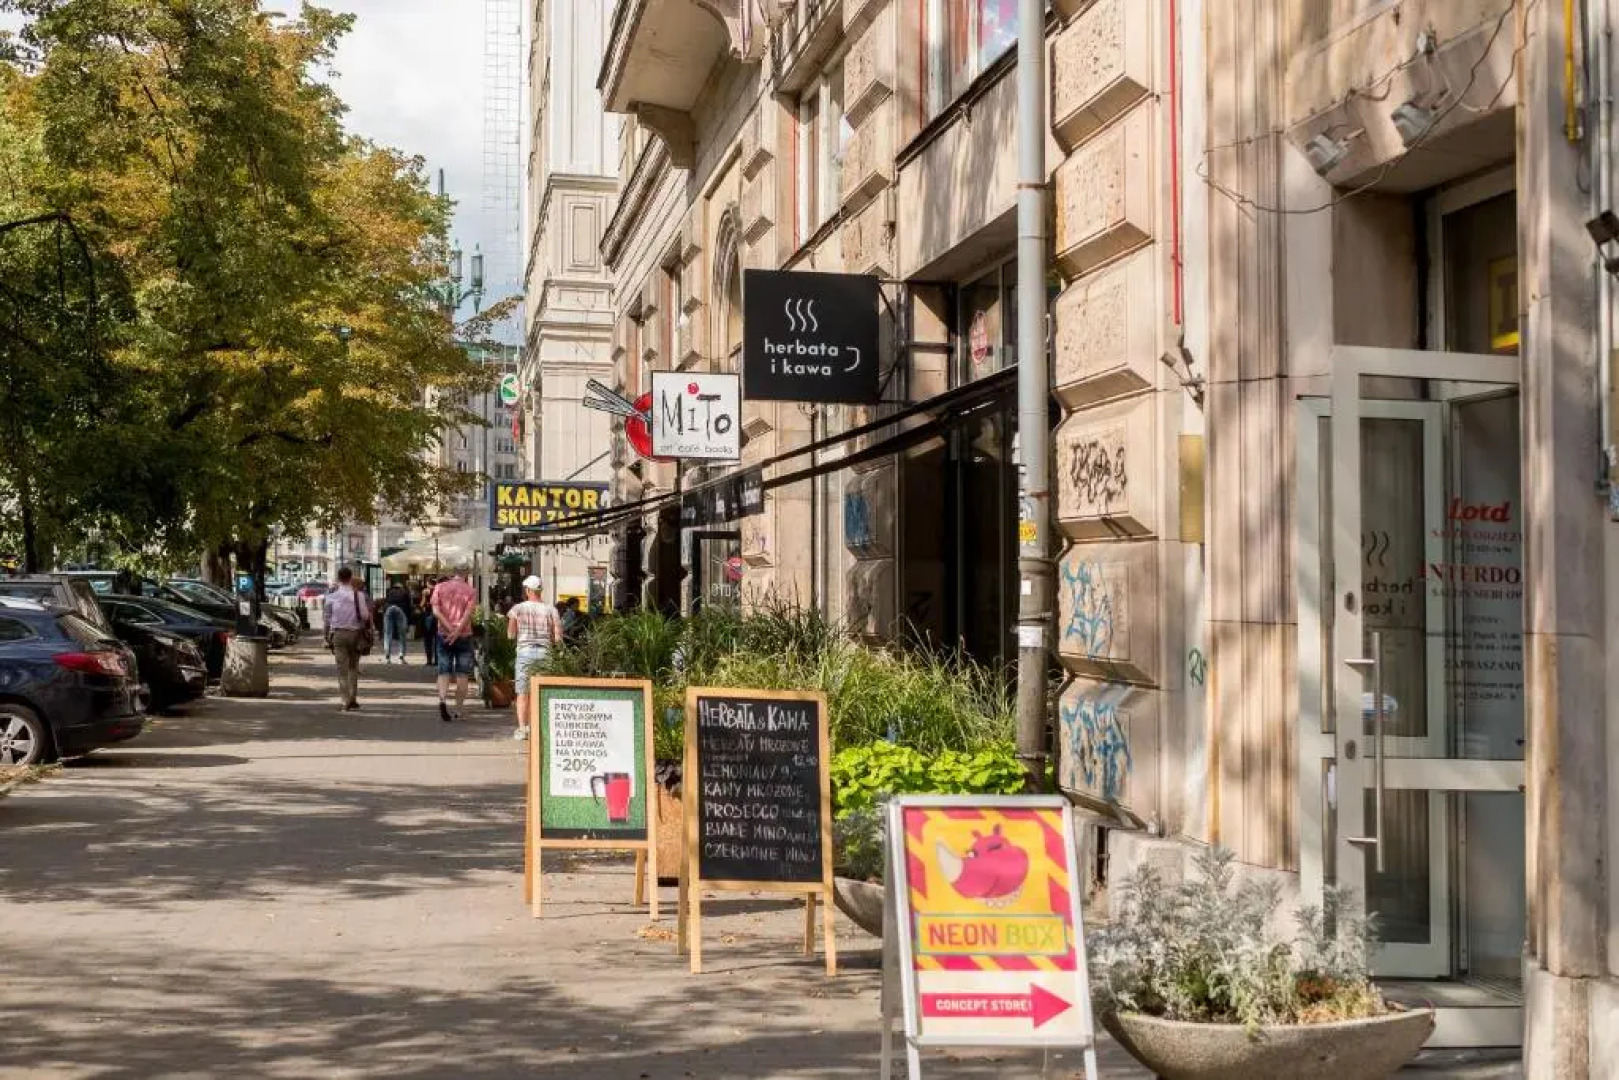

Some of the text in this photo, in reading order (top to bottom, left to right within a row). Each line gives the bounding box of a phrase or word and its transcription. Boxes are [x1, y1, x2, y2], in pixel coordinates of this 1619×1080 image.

[764, 337, 839, 356] herbata
[771, 358, 831, 376] i kawa
[497, 486, 599, 509] KANTOR
[497, 508, 541, 526] SKUP
[699, 700, 756, 730] HERBATA
[556, 758, 596, 772] -20%
[705, 802, 779, 820] PROSECCO
[928, 923, 1055, 948] NEON BOX
[935, 999, 988, 1011] CONCEPT
